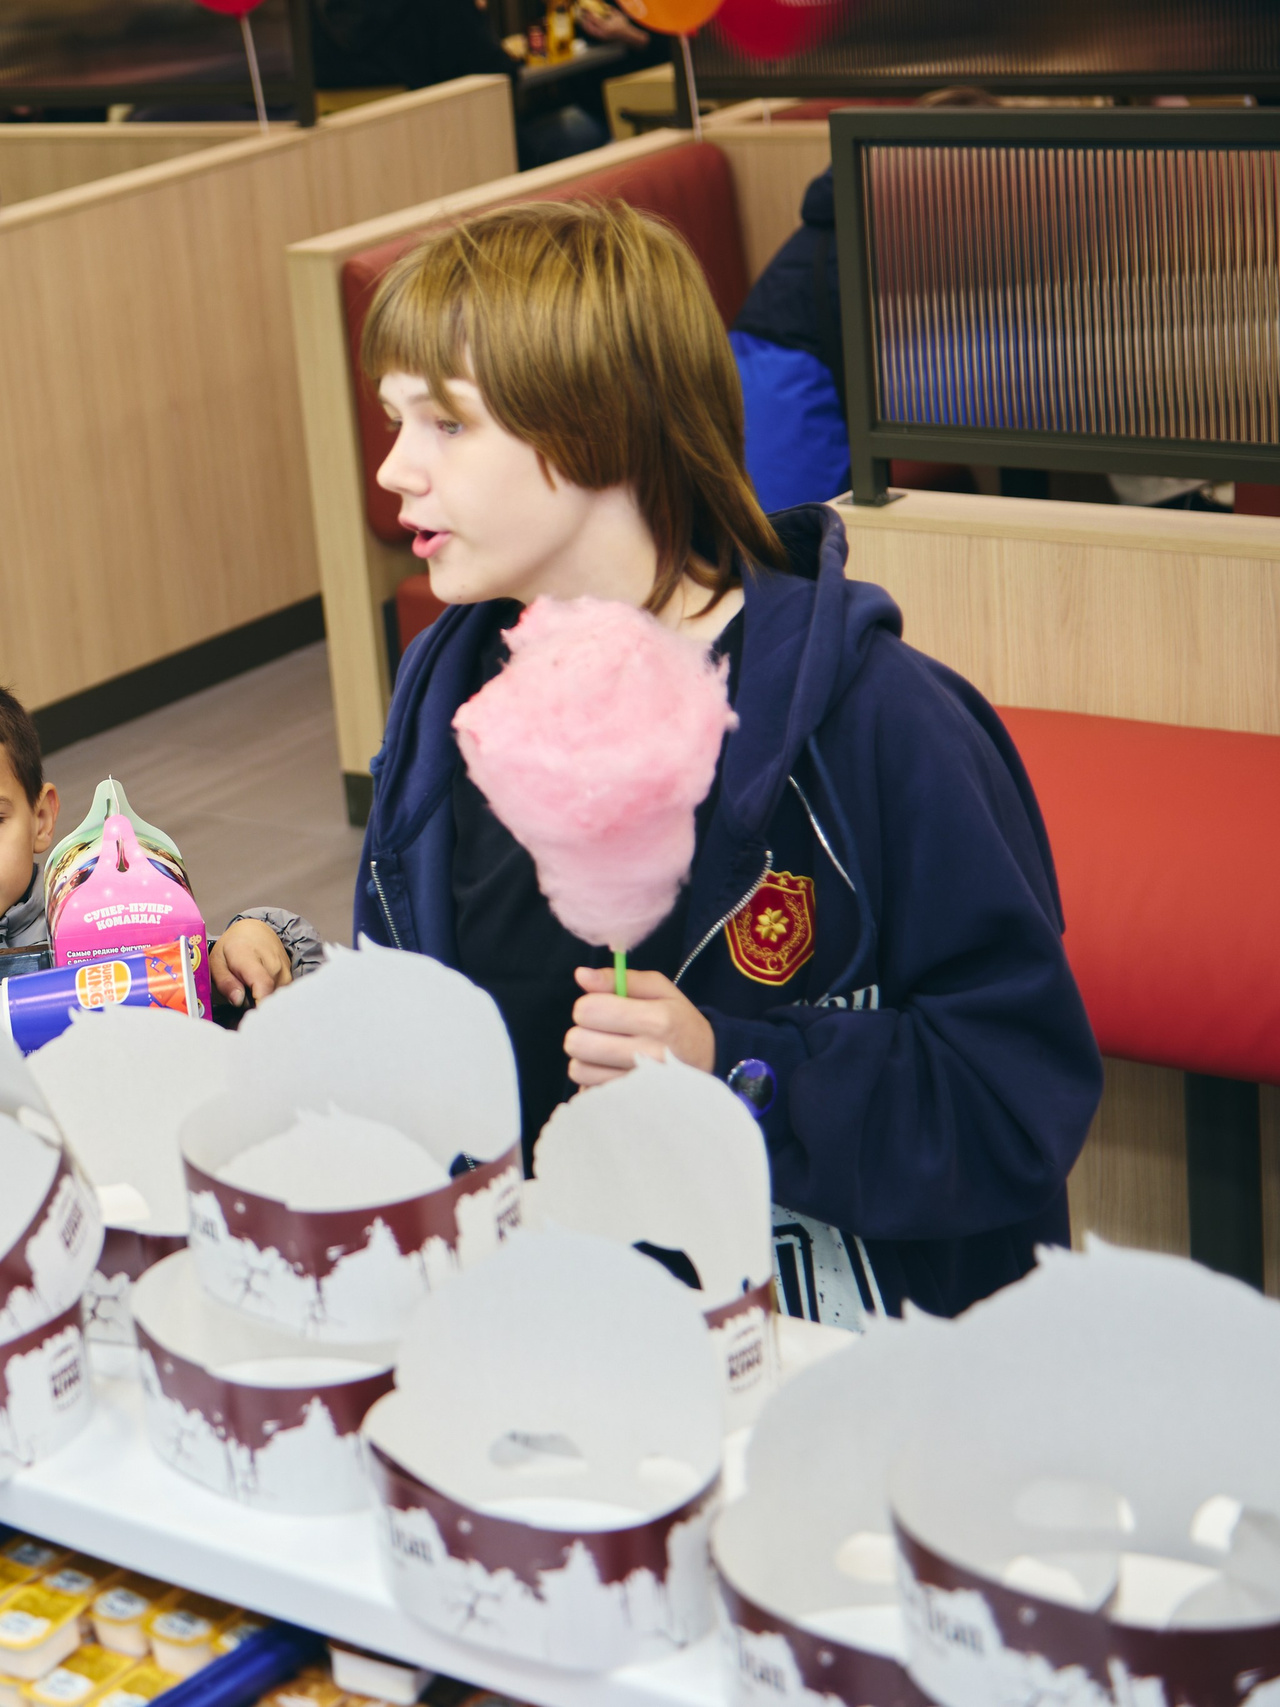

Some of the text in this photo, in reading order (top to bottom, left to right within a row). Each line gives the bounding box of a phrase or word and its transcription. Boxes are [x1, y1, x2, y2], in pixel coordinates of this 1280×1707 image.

[83, 903, 173, 923] СУПЕР-ПУПЕР
[96, 914, 161, 931] КОМАНДА!
[92, 947, 119, 957] редкие
[87, 965, 104, 1006] KING
